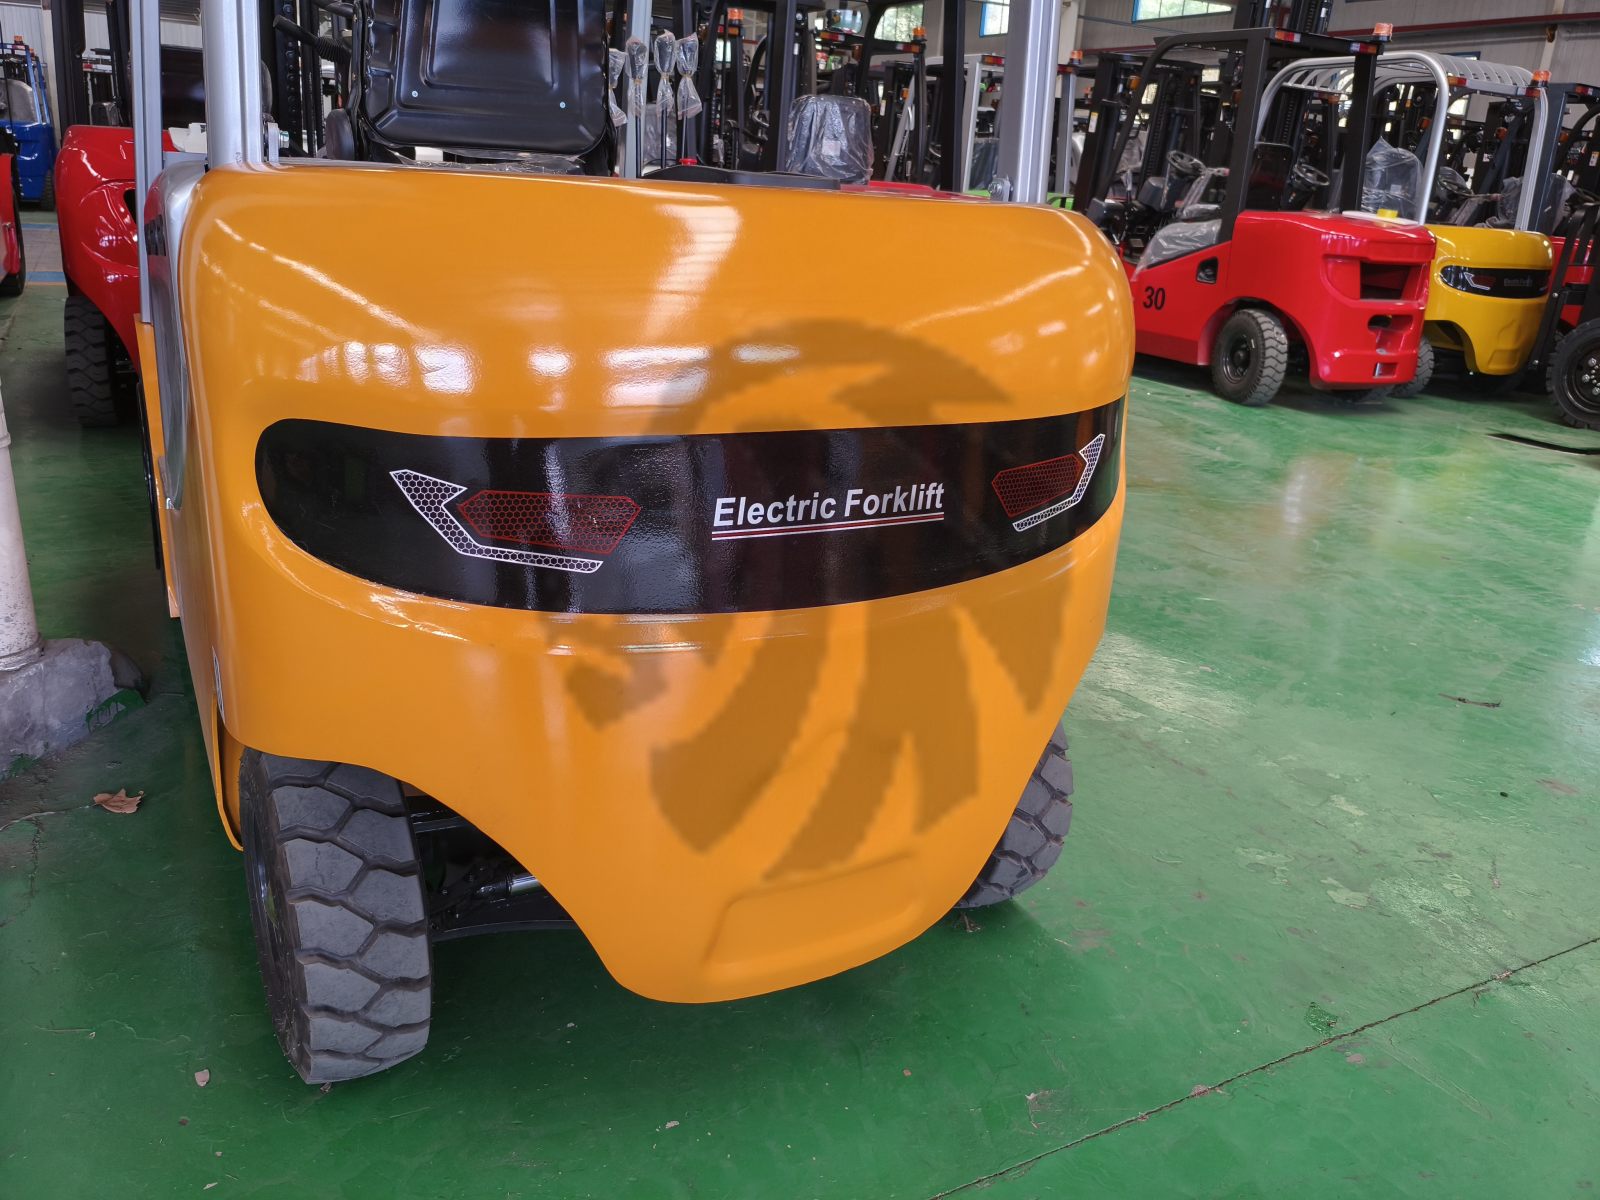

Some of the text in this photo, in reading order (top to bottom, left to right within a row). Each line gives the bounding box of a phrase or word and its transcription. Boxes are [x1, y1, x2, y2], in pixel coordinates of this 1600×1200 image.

[1143, 286, 1166, 310] 30
[713, 482, 945, 527] Electric Forklift
